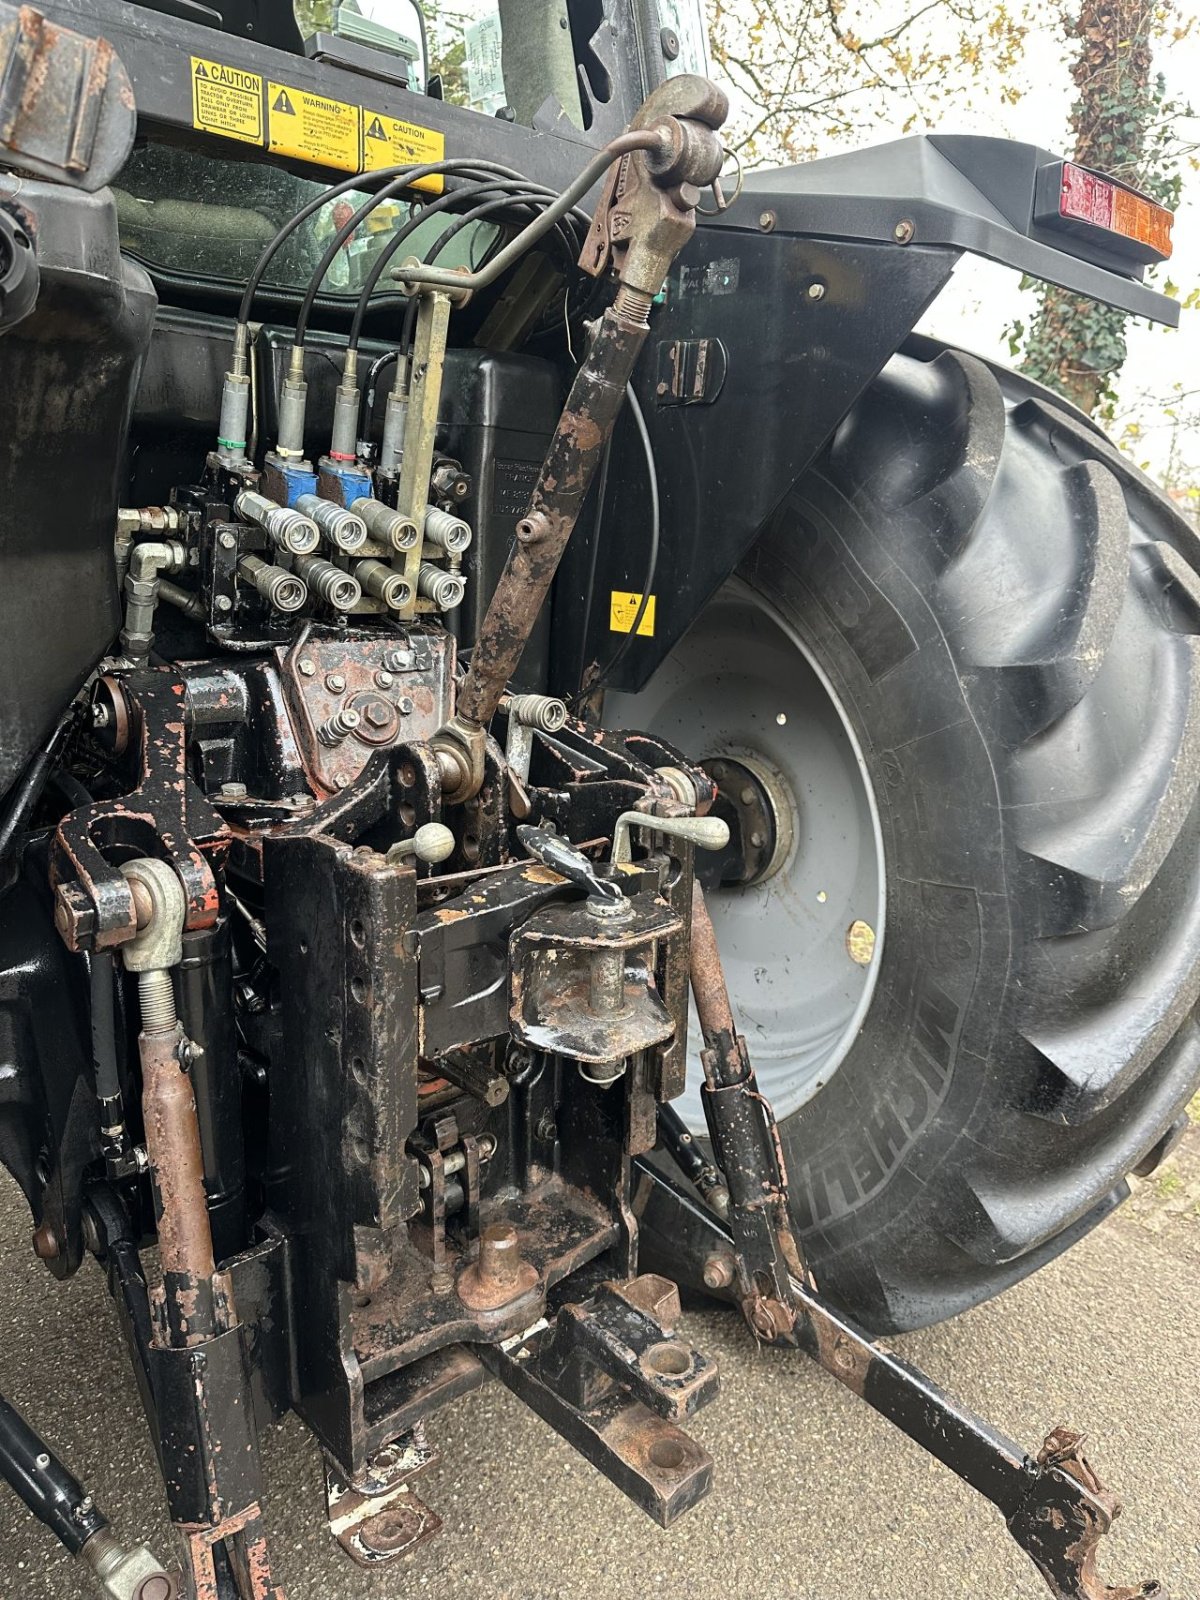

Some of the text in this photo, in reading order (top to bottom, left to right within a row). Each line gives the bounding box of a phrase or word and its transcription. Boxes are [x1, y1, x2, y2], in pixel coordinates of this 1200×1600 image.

[211, 66, 260, 92] CAUTION
[200, 89, 223, 100] TRACTOR
[210, 85, 228, 95] AVOID
[229, 91, 253, 102] POSSIBLE
[200, 96, 248, 113] PULL ONLY FROM
[201, 102, 227, 113] DRAWBAR
[240, 112, 257, 121] LOWER
[302, 96, 342, 114] WARNING
[201, 108, 217, 117] LINKS
[229, 116, 245, 125] THREE
[201, 115, 236, 128] POINT HITCH
[392, 123, 425, 140] CAUTION
